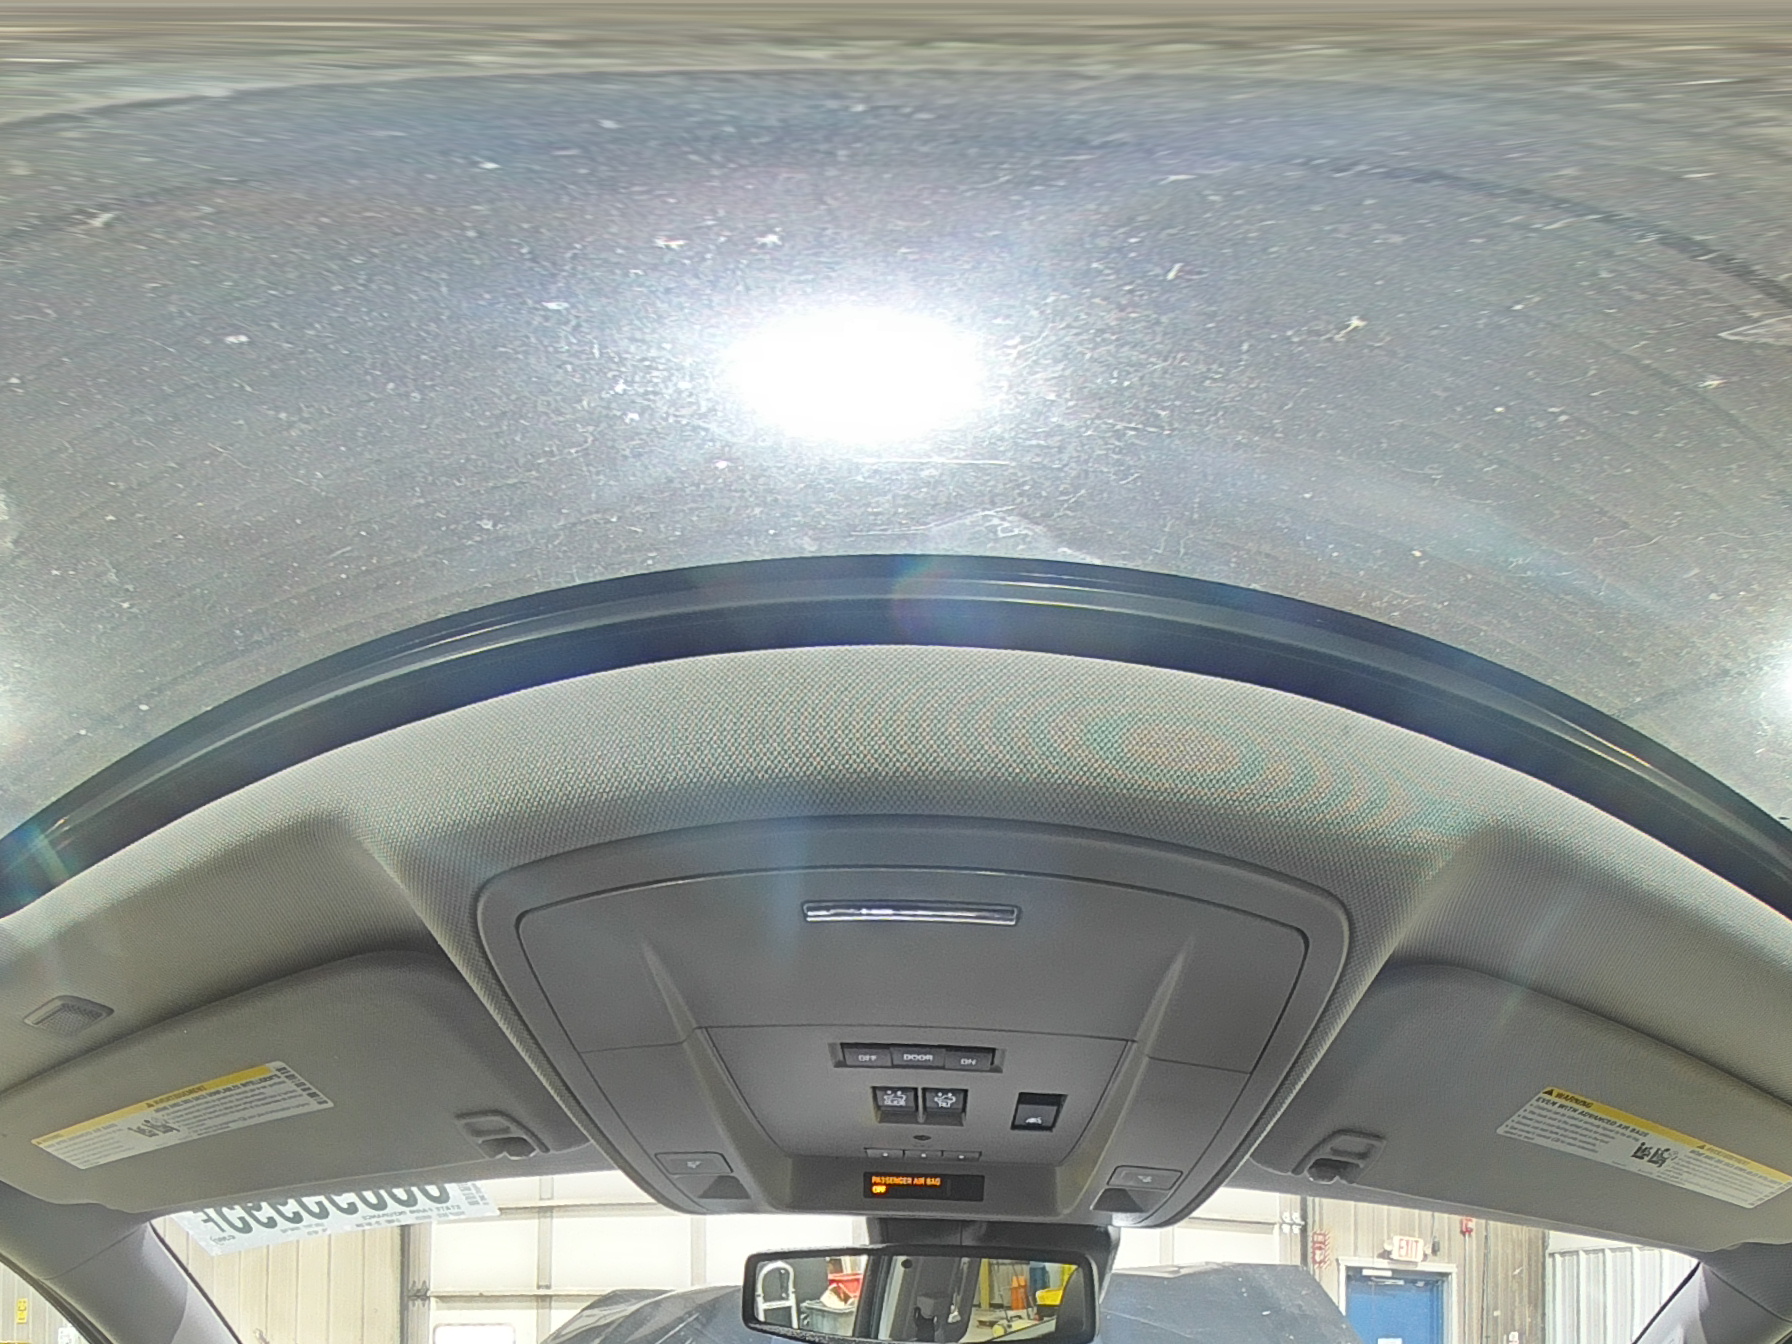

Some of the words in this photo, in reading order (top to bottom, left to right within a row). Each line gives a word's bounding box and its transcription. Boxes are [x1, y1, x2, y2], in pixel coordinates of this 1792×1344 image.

[1555, 1092, 1594, 1109] WARNING
[1557, 1103, 1579, 1114] WITH
[872, 1176, 912, 1185] PASSENGER
[913, 1177, 925, 1185] AIR
[926, 1177, 941, 1186] BAG
[872, 1185, 886, 1193] OFF
[1398, 1238, 1420, 1259] EXIT
